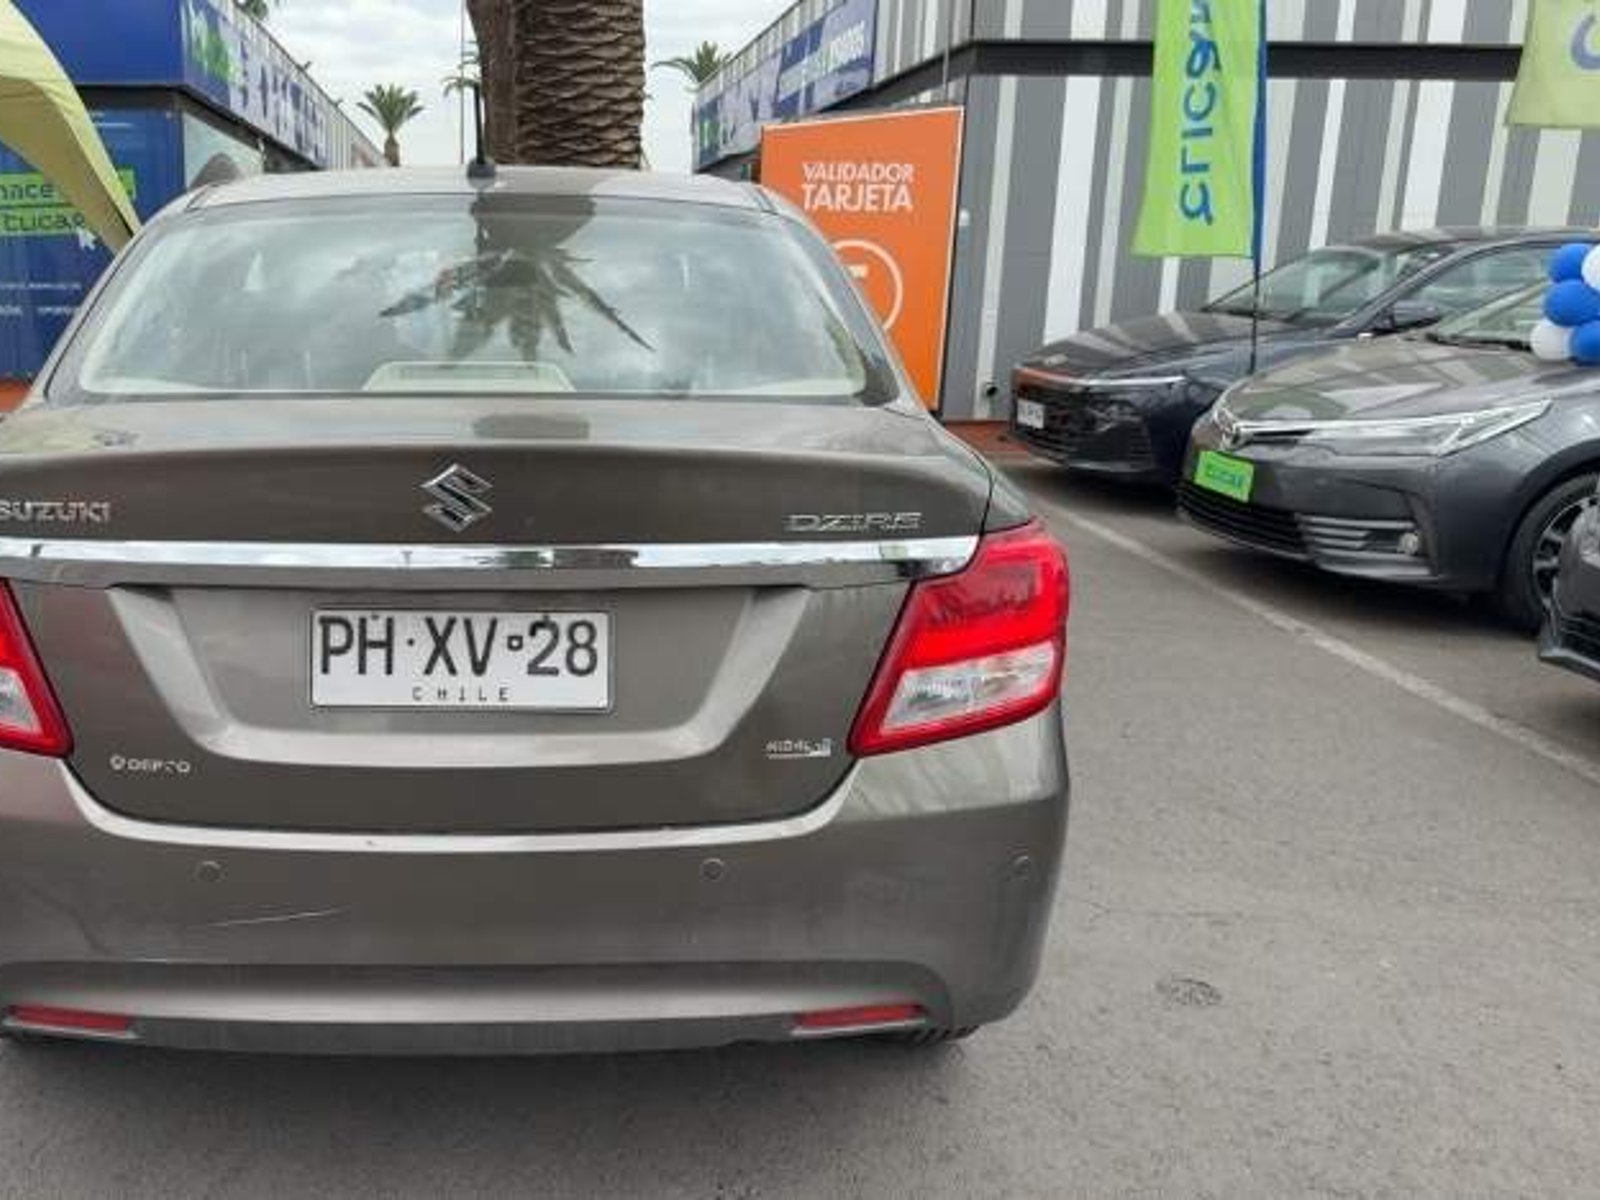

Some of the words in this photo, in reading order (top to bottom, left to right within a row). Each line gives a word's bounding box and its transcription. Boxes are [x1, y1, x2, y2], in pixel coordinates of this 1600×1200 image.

[802, 162, 915, 182] VALIDADOR
[801, 184, 914, 212] TARJETA
[412, 686, 510, 702] CHILE
